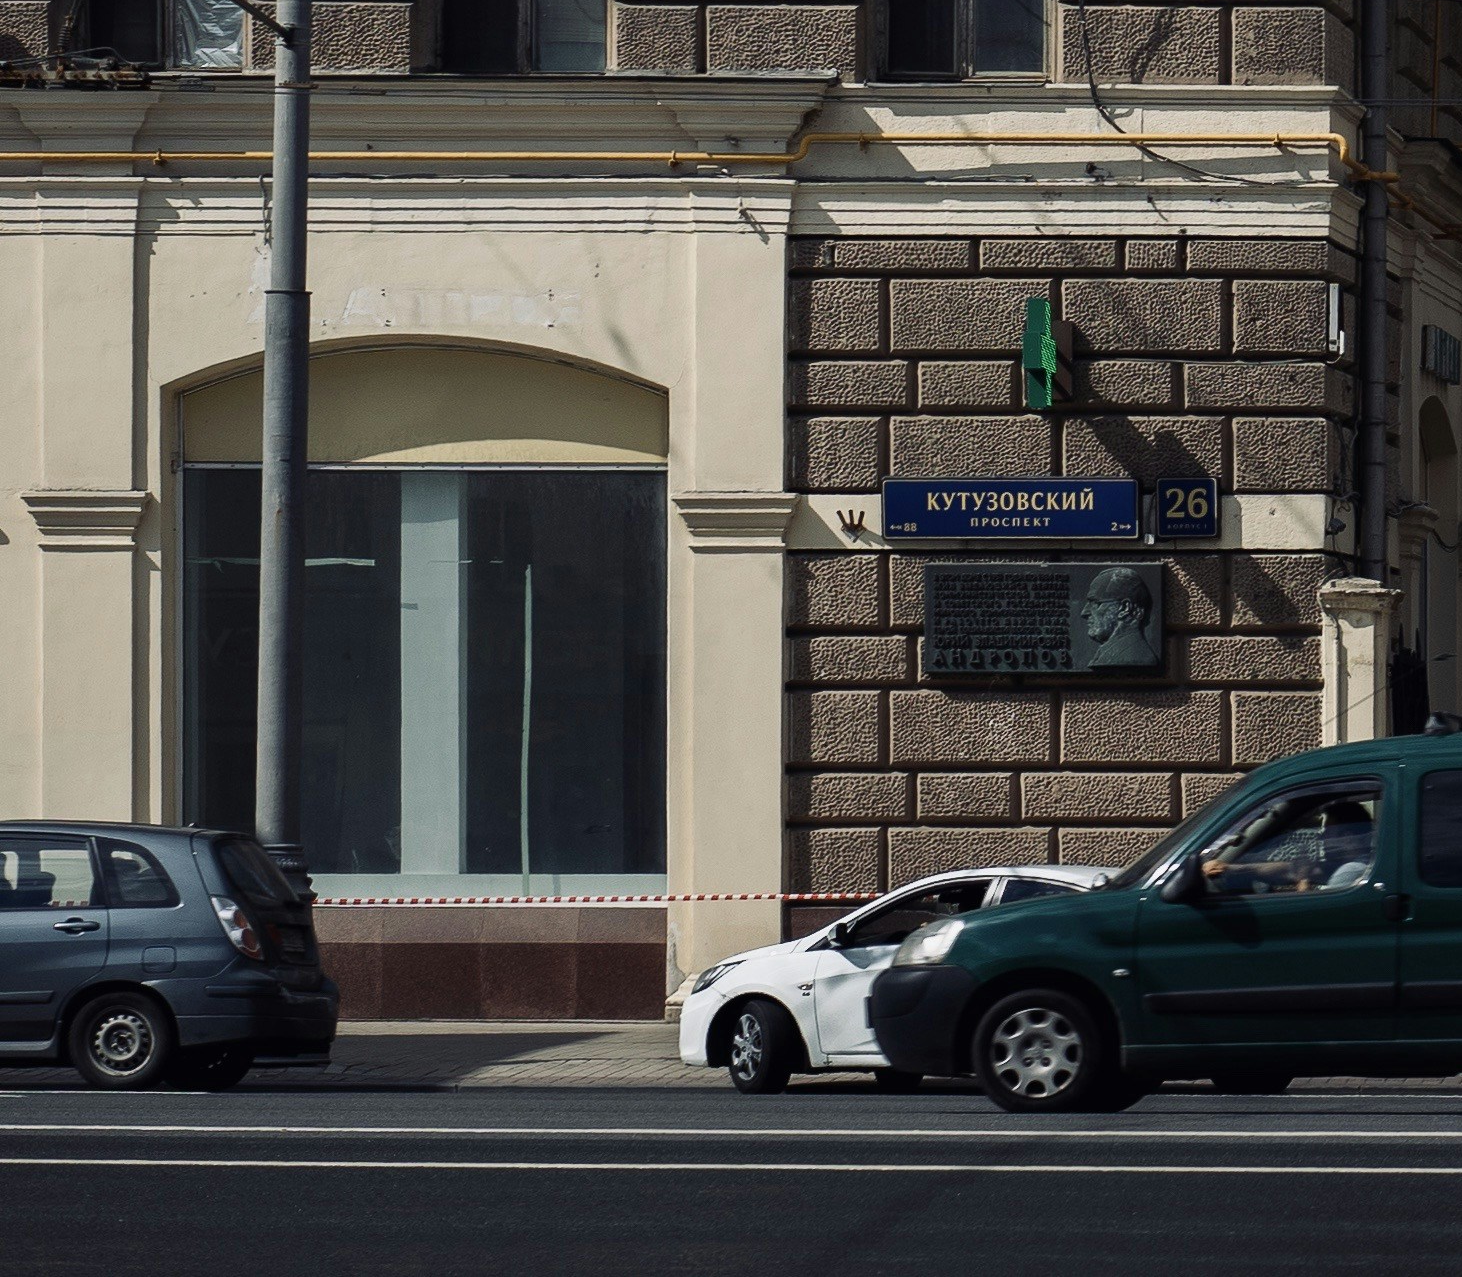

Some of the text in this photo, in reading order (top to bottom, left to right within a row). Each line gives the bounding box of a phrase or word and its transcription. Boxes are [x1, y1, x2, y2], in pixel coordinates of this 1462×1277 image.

[927, 488, 1095, 511] КУТУЗОВСКИЙ
[1166, 488, 1208, 518] 26
[903, 522, 917, 532] 88
[970, 517, 1051, 527] ПРОСПЕКТ
[1111, 522, 1118, 531] 2
